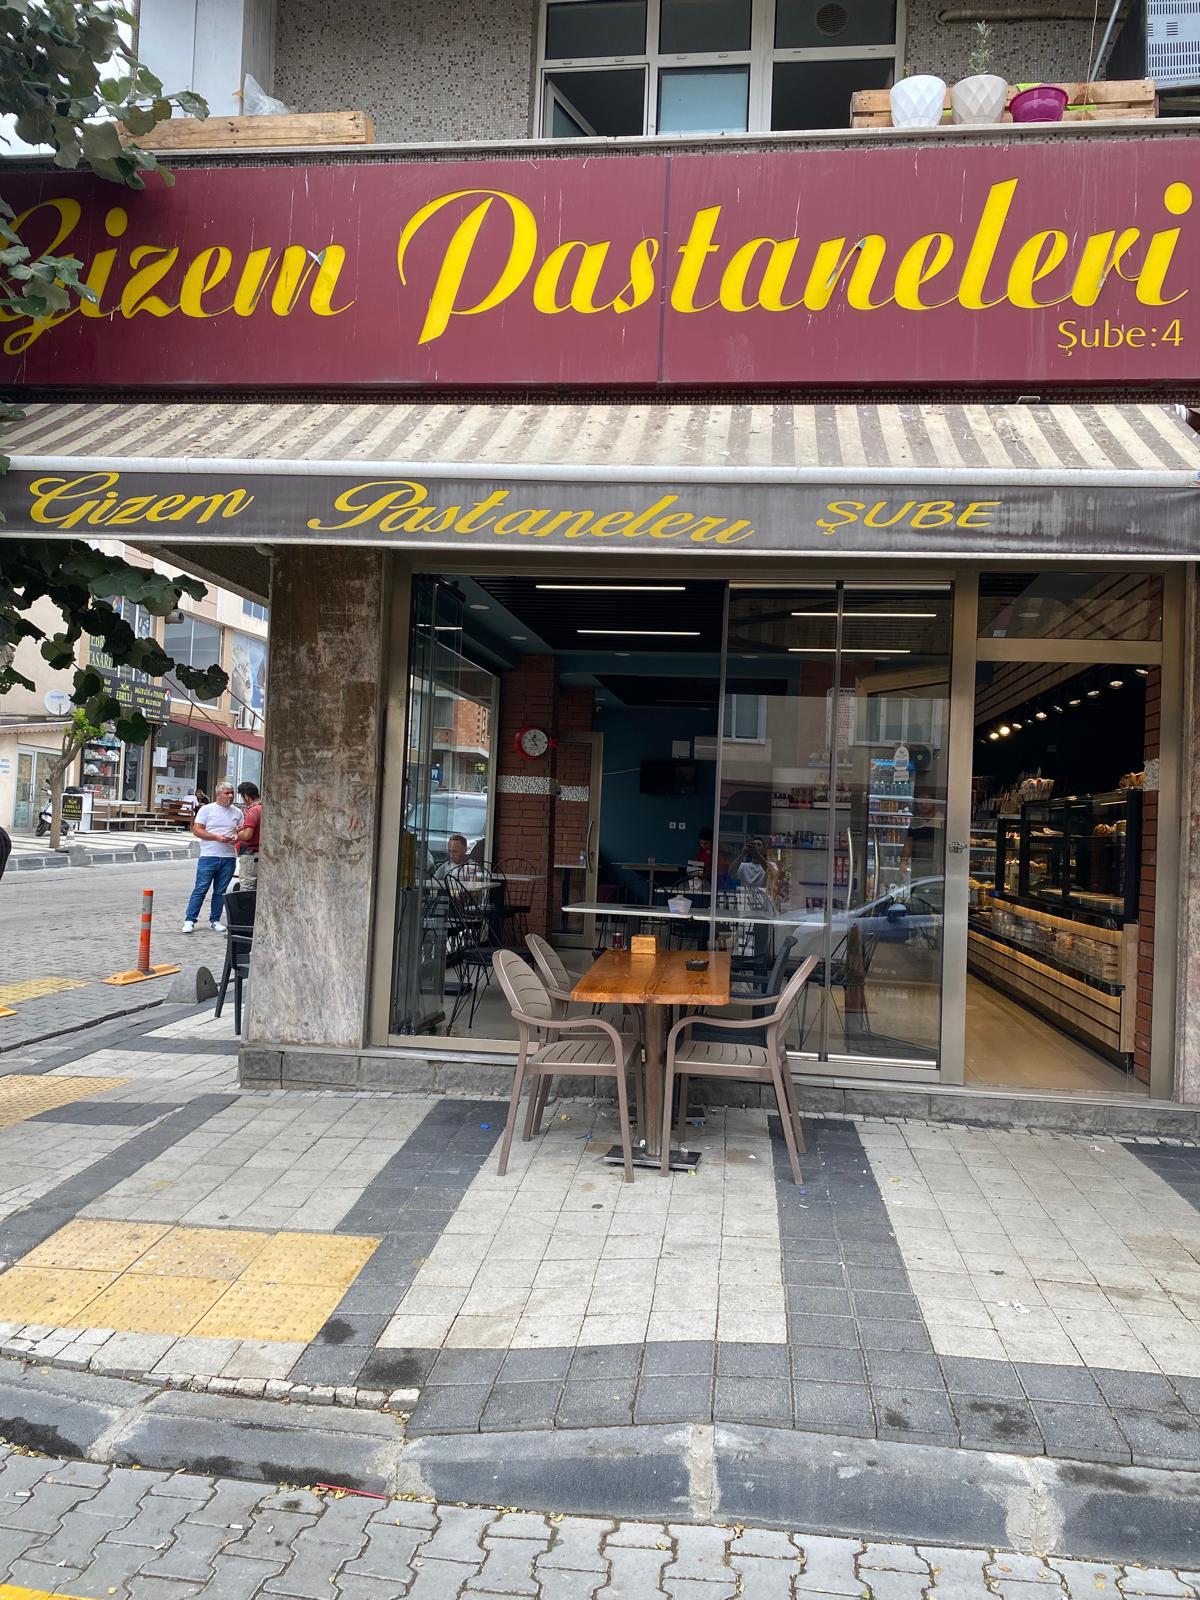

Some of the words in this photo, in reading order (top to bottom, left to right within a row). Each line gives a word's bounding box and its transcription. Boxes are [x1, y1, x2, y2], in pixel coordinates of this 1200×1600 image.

[397, 177, 1193, 345] Pastaneleri
[1057, 319, 1184, 356] Şube:4
[29, 472, 255, 529] Gizem
[815, 500, 1002, 535] ŞUBE
